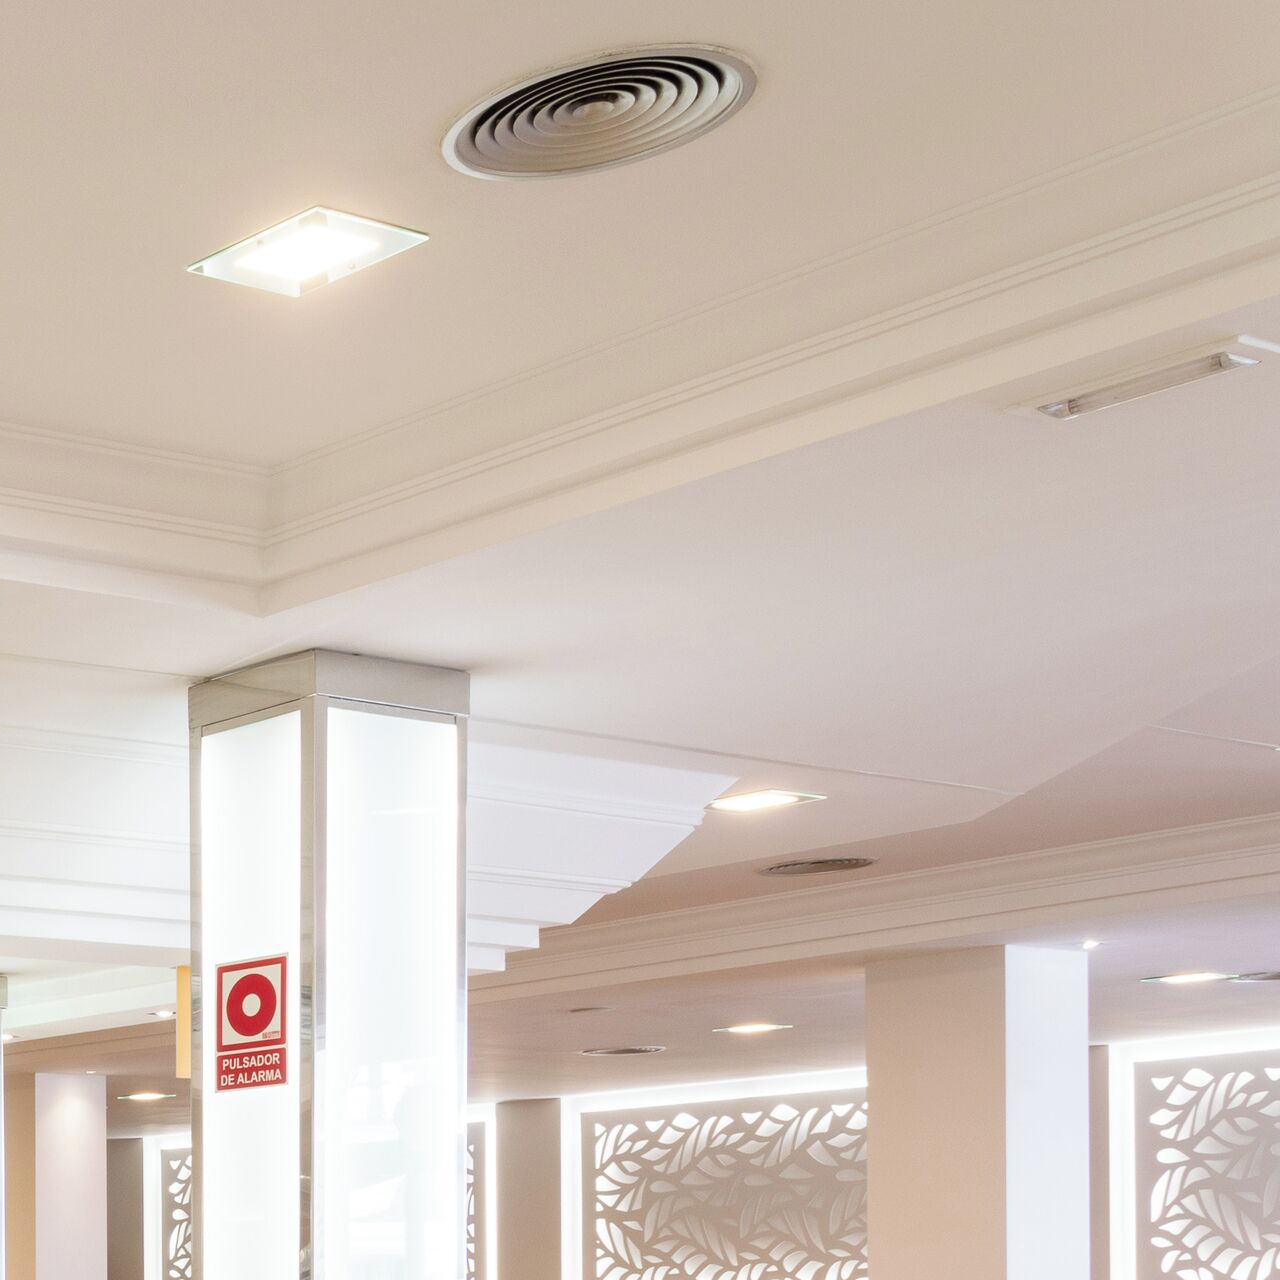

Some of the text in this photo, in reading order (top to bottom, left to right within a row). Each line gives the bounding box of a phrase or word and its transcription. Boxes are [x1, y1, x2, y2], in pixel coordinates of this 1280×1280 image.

[222, 1052, 280, 1071] PULSADOR
[221, 1069, 282, 1086] DE ALARMA
